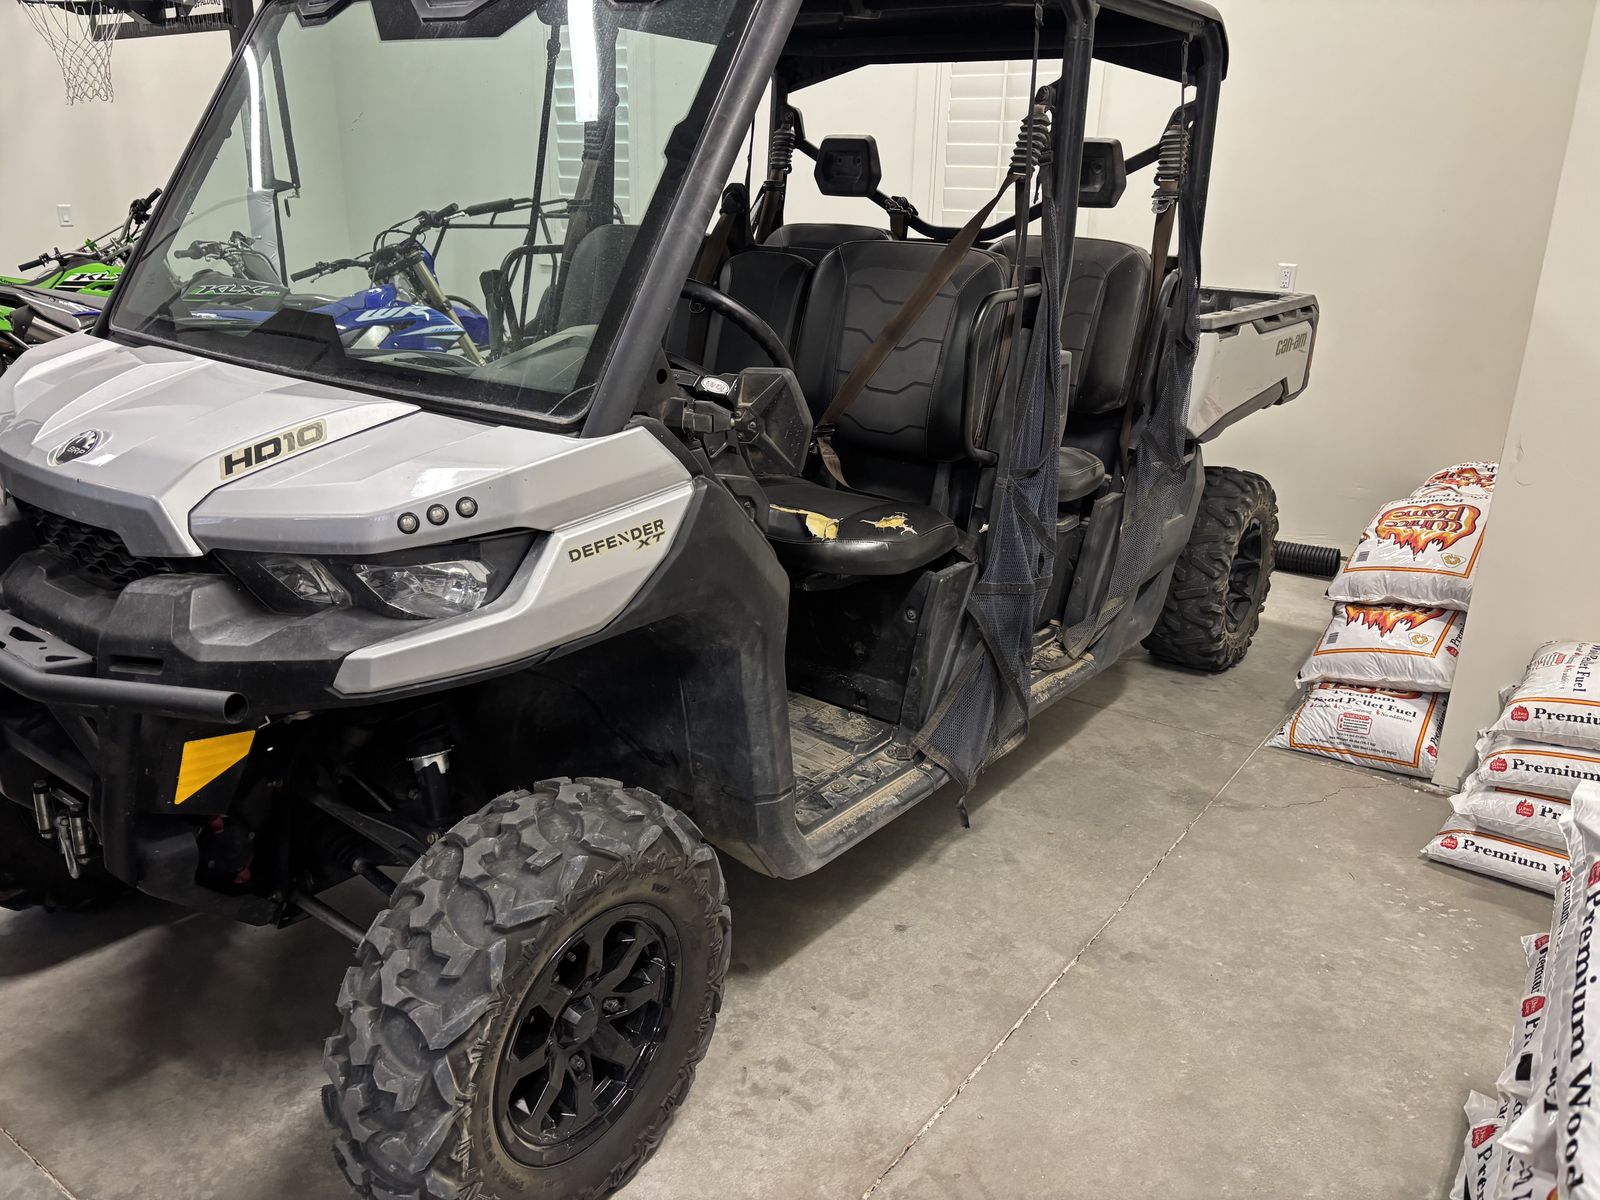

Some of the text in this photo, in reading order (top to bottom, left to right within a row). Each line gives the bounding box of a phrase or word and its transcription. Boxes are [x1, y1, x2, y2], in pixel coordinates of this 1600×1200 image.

[196, 284, 269, 295] KLX
[1275, 331, 1308, 356] can-am
[67, 445, 86, 455] BRP
[224, 421, 324, 476] HD10
[568, 518, 664, 562] DEFENDER
[636, 531, 665, 551] XT
[1573, 670, 1591, 692] Fuel
[1346, 697, 1384, 710] Pellet
[1388, 704, 1418, 719] Fuel
[1462, 838, 1547, 872] Premium
[1570, 890, 1600, 1063] Premium
[1565, 1062, 1593, 1198] Wood
